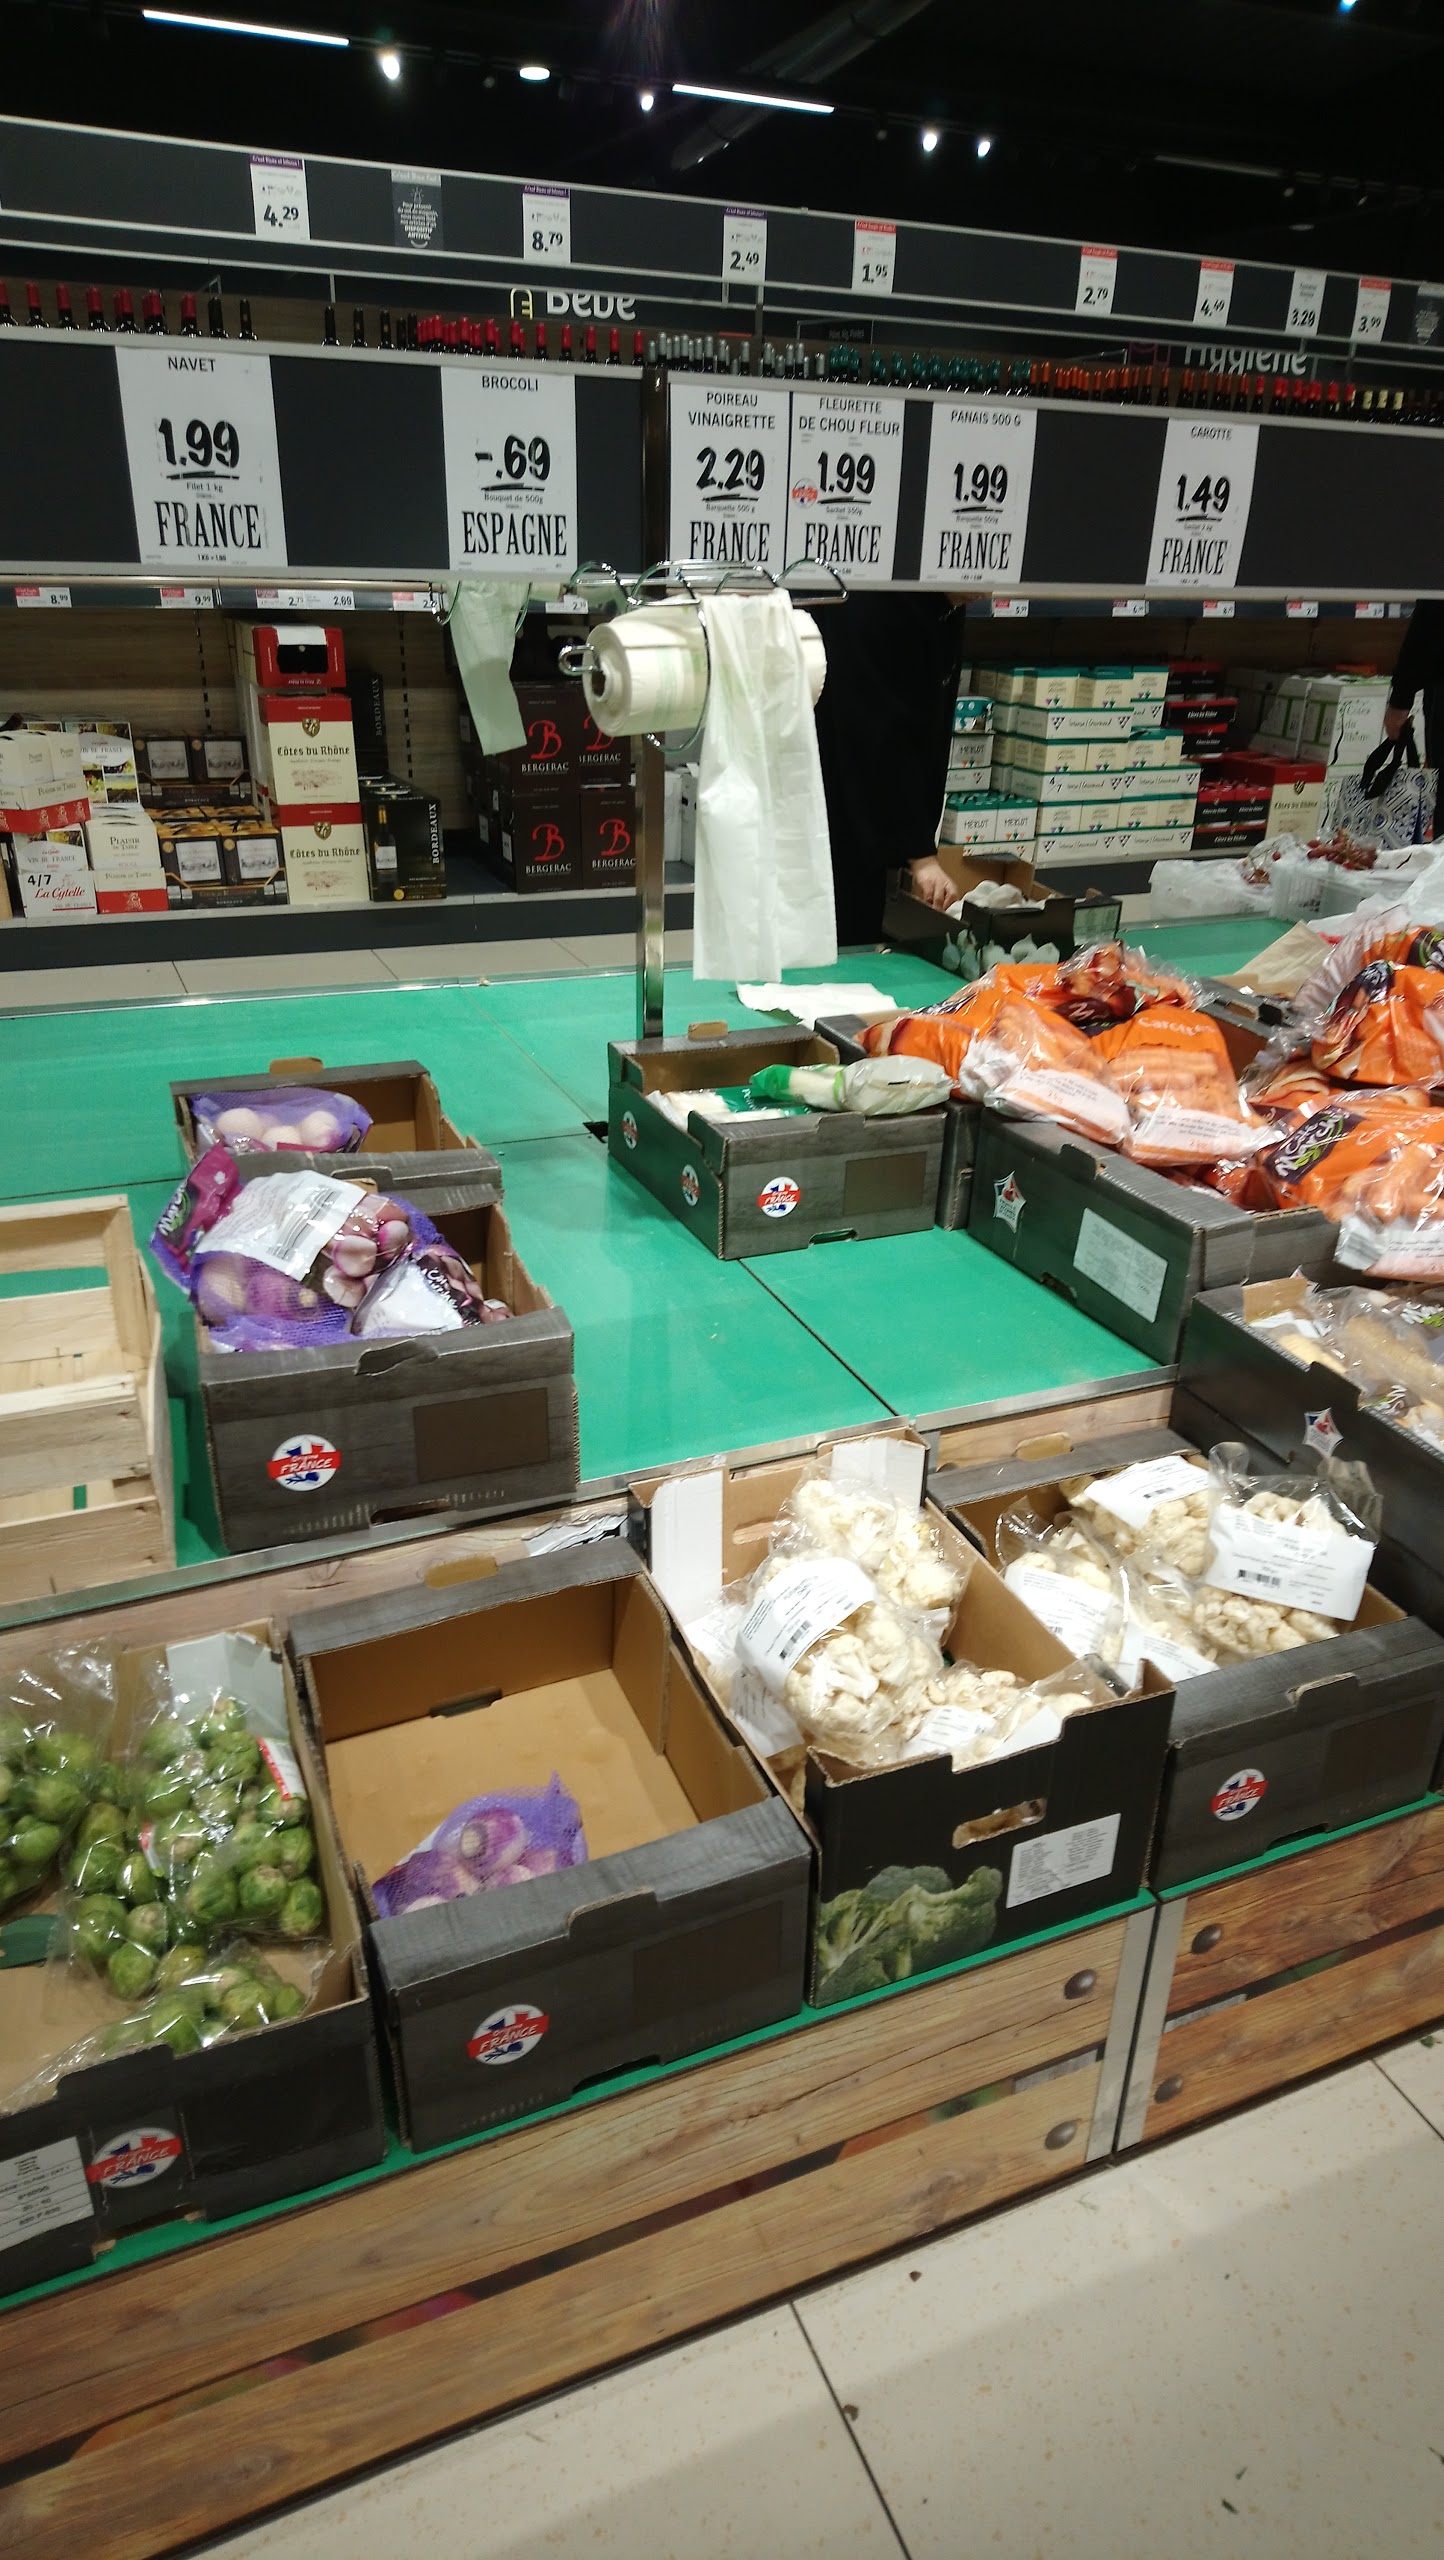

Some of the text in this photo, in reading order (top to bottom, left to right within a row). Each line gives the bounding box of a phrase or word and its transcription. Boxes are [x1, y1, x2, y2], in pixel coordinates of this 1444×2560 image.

[263, 204, 299, 228] 4.29
[532, 230, 564, 252] 8.79
[729, 250, 760, 272] 2.49
[861, 263, 888, 284] 1.95
[1082, 286, 1108, 306] 2.79
[1200, 299, 1225, 317] 4.49
[1357, 315, 1381, 333] 3.99
[167, 356, 216, 372] NAVET
[481, 375, 539, 392] BROCOLI
[706, 391, 758, 407] POIREAU
[818, 397, 882, 415] FLEURETTE
[688, 411, 776, 430] VINAIGRETTE
[799, 416, 901, 437] DE CHOU FLEUR
[950, 409, 1022, 428] PANAIS 500 G
[158, 417, 240, 469] 1.99
[1190, 425, 1233, 441] CAROTTE
[474, 433, 551, 481] -.69
[695, 446, 765, 491] 2.29
[817, 450, 876, 495] 1.99
[186, 482, 204, 491] Filet
[213, 483, 224, 493] kg
[953, 461, 1008, 505] 1.99
[484, 493, 513, 503] Bouquet
[1176, 473, 1231, 514] 1.49
[154, 500, 262, 549] FRANCE
[461, 510, 568, 557] ESPAGNE
[689, 520, 770, 563] FRANCE
[804, 522, 882, 563] FRANCE
[937, 530, 1012, 571] FRANCE
[1159, 537, 1228, 575] FRANCE
[50, 593, 69, 605] 8.99
[194, 594, 212, 606] 9.99
[371, 677, 383, 737] BORDEAUX
[528, 719, 562, 760] B
[306, 745, 318, 756] du
[521, 761, 570, 773] BERGERAC
[963, 818, 990, 830] MERLOT
[1004, 816, 1029, 827] MERLOT
[428, 802, 440, 865] BORDEAUX
[532, 822, 565, 862] B
[600, 818, 631, 857] B
[317, 847, 330, 858] du
[525, 862, 572, 875] BERGERAC
[591, 857, 637, 869] BERGERAC
[27, 873, 52, 888] 4/7
[34, 888, 50, 899] La
[764, 1193, 796, 1205] FRANCE
[280, 1457, 333, 1475] FRANCE
[1217, 1787, 1260, 1808] FRANCE
[480, 2023, 538, 2052] FRANCE
[103, 2146, 170, 2177] FRANCE
